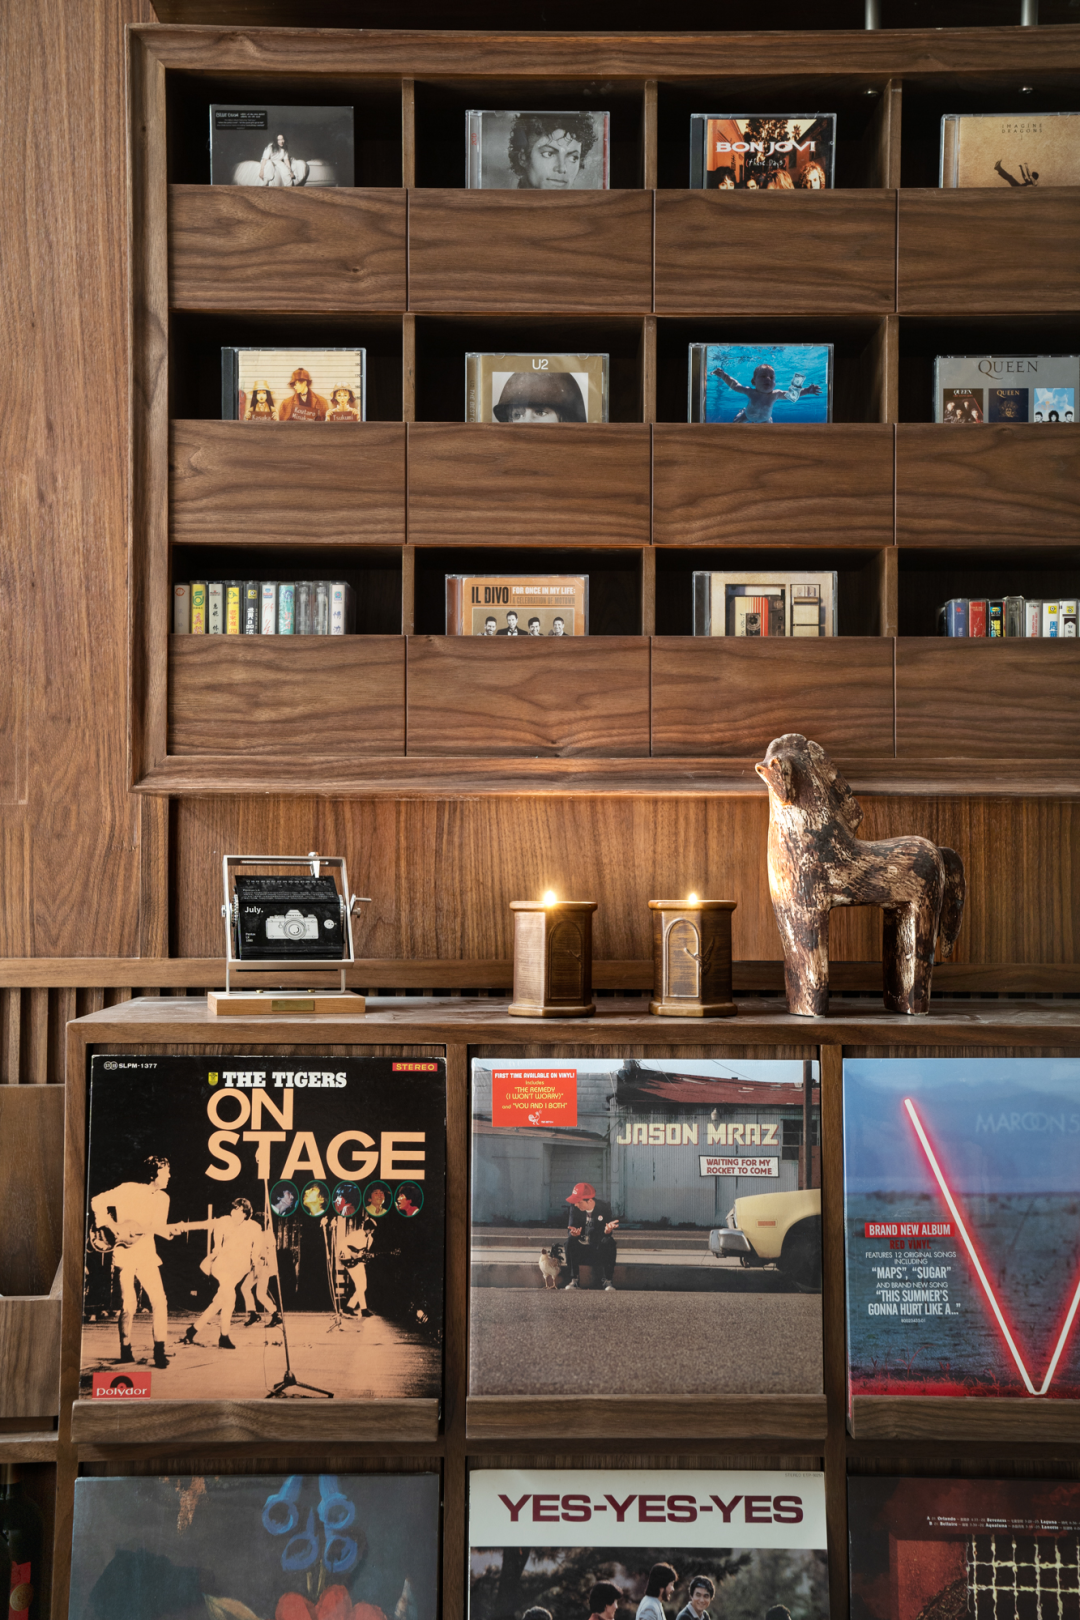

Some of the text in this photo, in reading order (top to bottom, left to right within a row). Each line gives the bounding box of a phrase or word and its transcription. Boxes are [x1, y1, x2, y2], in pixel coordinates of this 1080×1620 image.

[716, 141, 816, 156] BON JOVI
[532, 358, 548, 370] U2
[978, 360, 1038, 380] QUEEN
[996, 390, 1020, 398] QUEEN
[472, 586, 509, 604] IL DIVO
[244, 906, 264, 914] July.
[223, 1072, 347, 1088] THE TIGERS
[207, 1088, 294, 1130] ON
[975, 1111, 1080, 1134] MAROON 5
[616, 1124, 780, 1146] JASON MRAZ
[205, 1130, 426, 1181] STAGE
[759, 1158, 770, 1166] MY
[869, 1224, 950, 1236] BRAND NEW ALBUM
[890, 1240, 932, 1250] RED VINYL
[868, 1303, 898, 1315] GONNA
[900, 1303, 922, 1315] HURT
[924, 1303, 943, 1315] LIKE
[96, 1387, 147, 1396] polydor
[498, 1494, 804, 1524] YES-YES-YES
